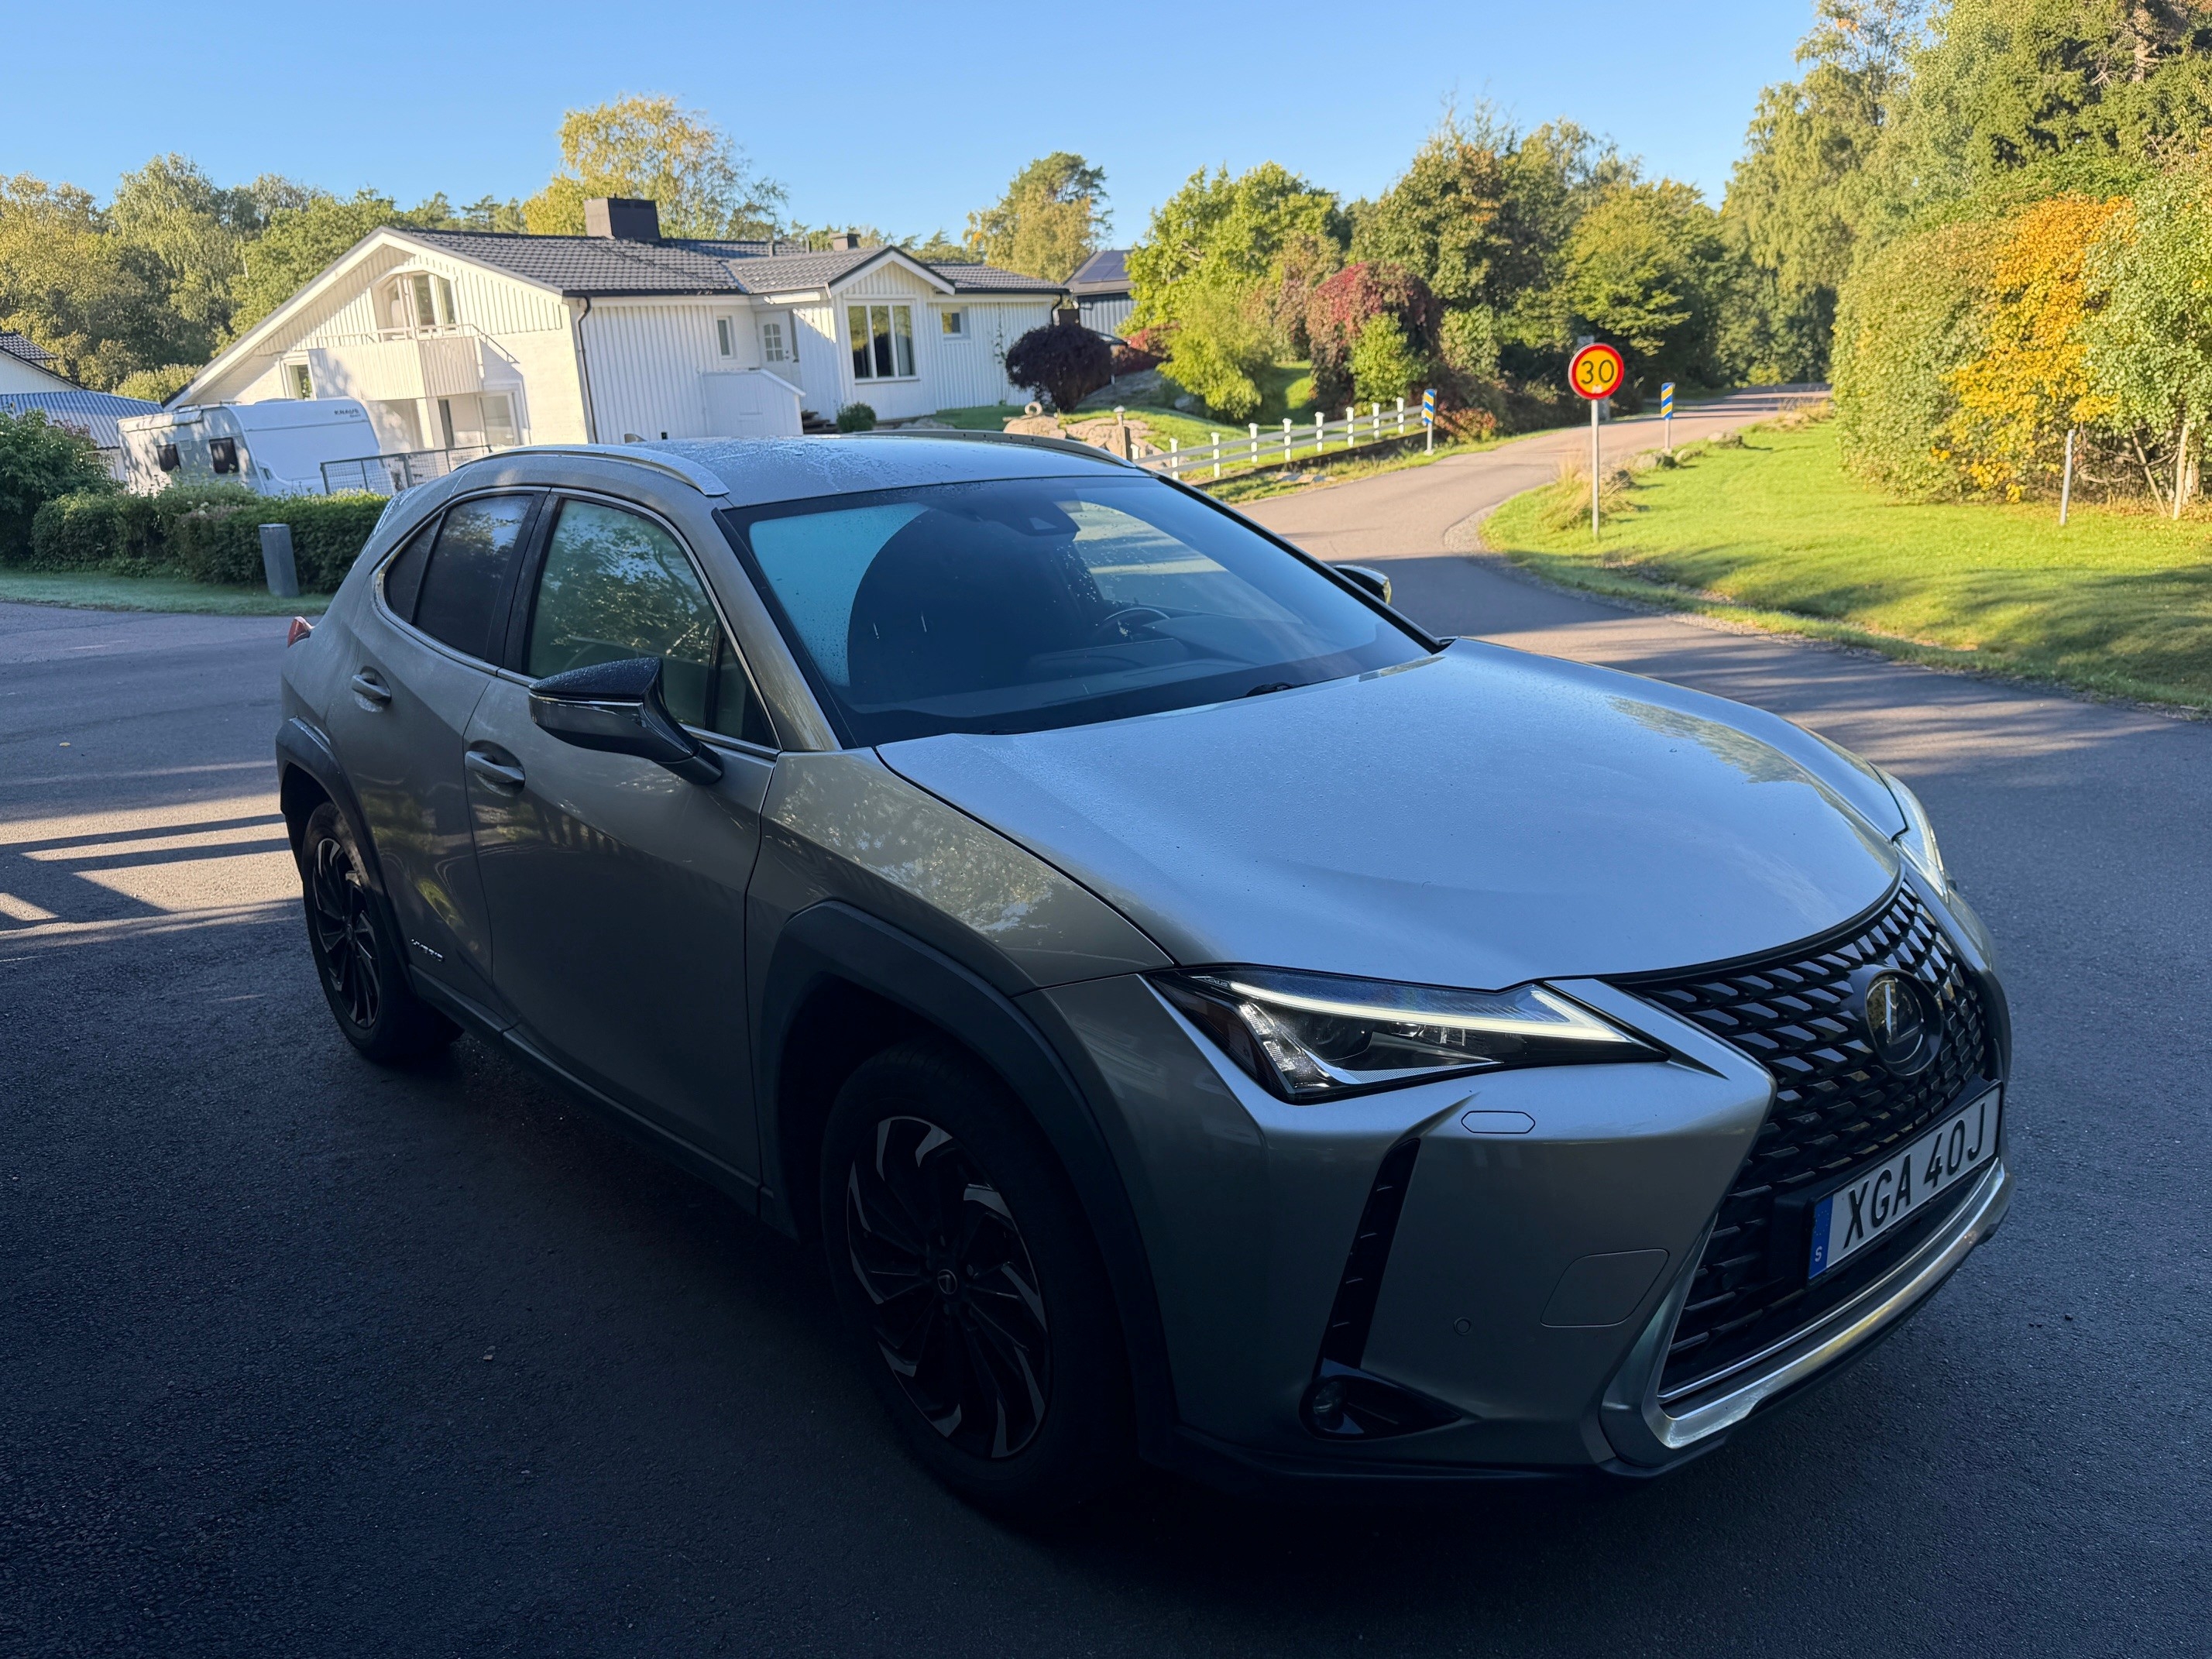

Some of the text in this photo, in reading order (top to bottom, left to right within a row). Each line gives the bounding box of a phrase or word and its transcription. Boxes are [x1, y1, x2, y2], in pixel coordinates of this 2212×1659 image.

[1581, 359, 1615, 384] 30
[1843, 1102, 1986, 1250] XGA 40J
[1814, 1245, 1823, 1263] S
